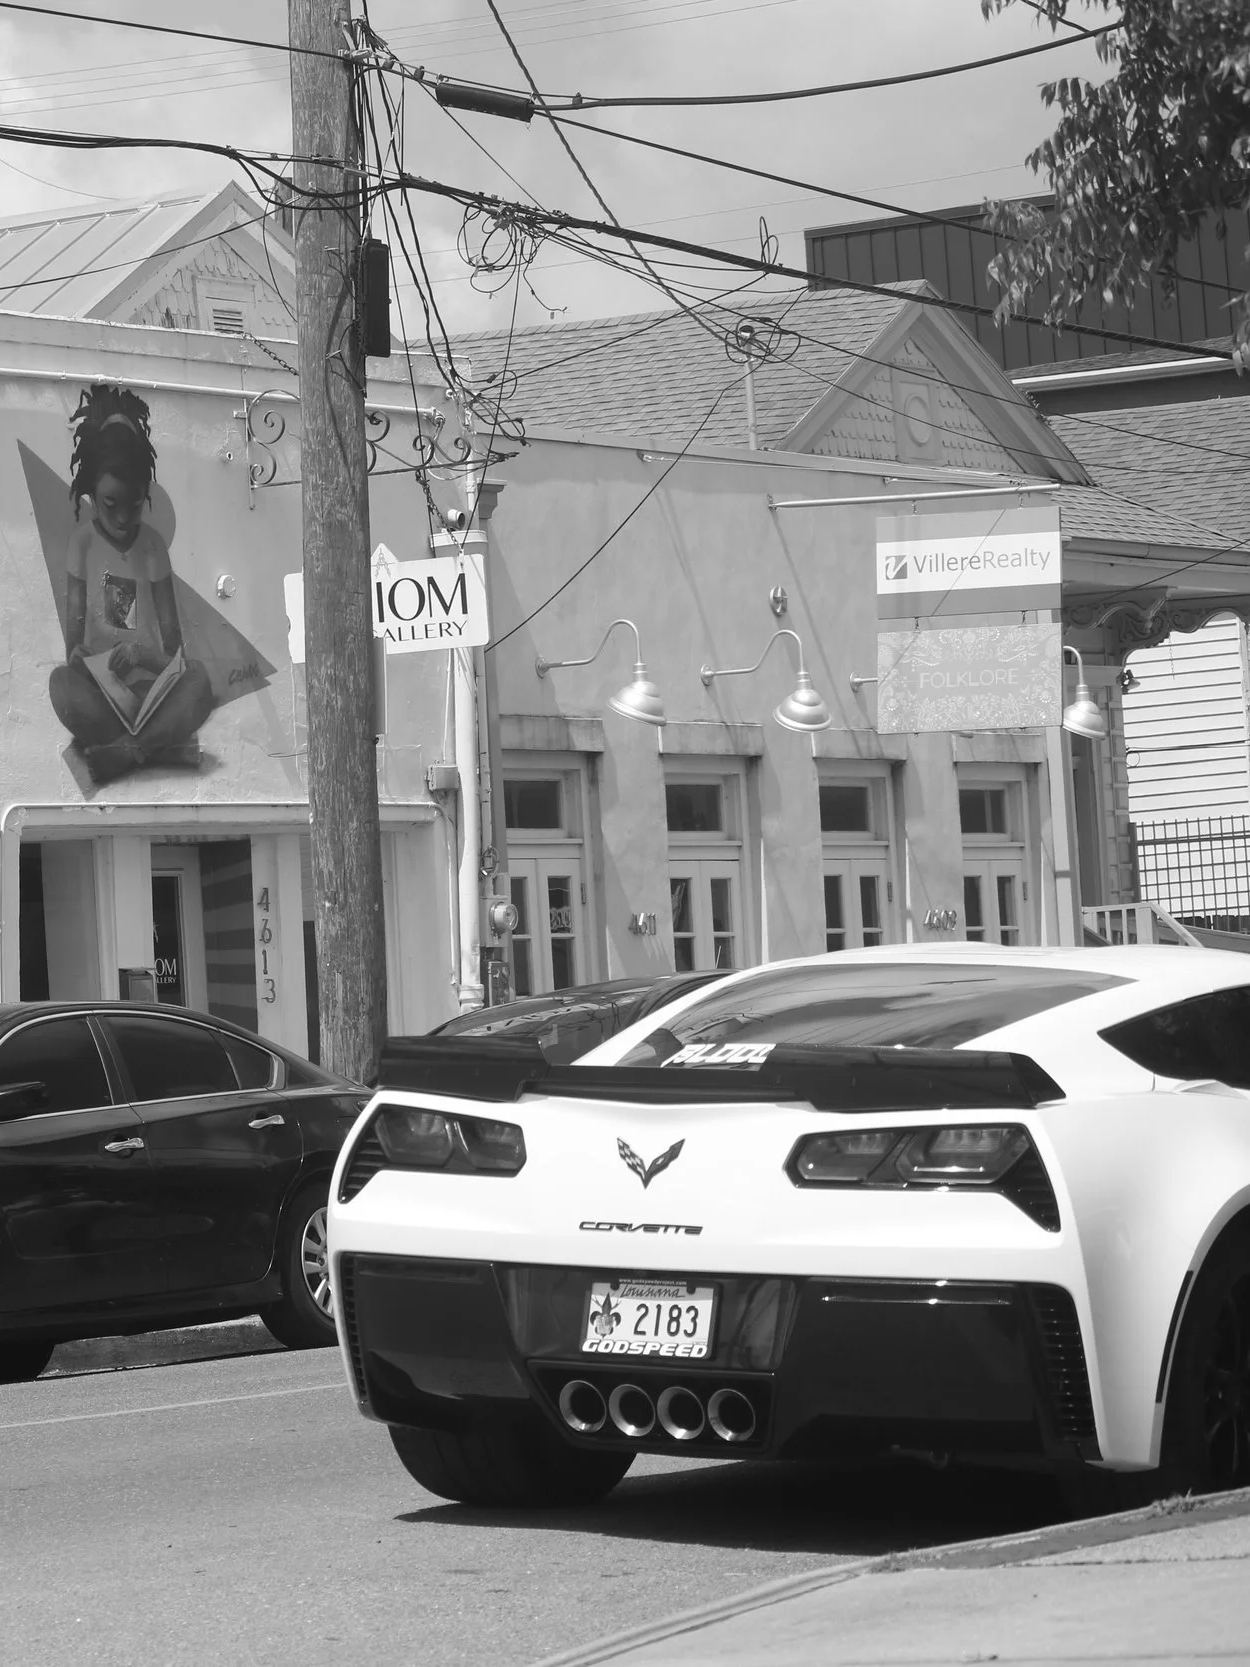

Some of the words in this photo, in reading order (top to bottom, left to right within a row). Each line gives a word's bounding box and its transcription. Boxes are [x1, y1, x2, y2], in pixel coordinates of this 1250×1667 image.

[913, 548, 1051, 574] VillereRealty
[376, 572, 469, 623] IOM
[919, 668, 1019, 689] FOLKLORE
[257, 886, 276, 1004] 4613
[579, 1221, 703, 1235] CORVETTE
[620, 1283, 686, 1299] Louisiana
[633, 1303, 699, 1338] 2183
[582, 1338, 708, 1358] GODSPEED
